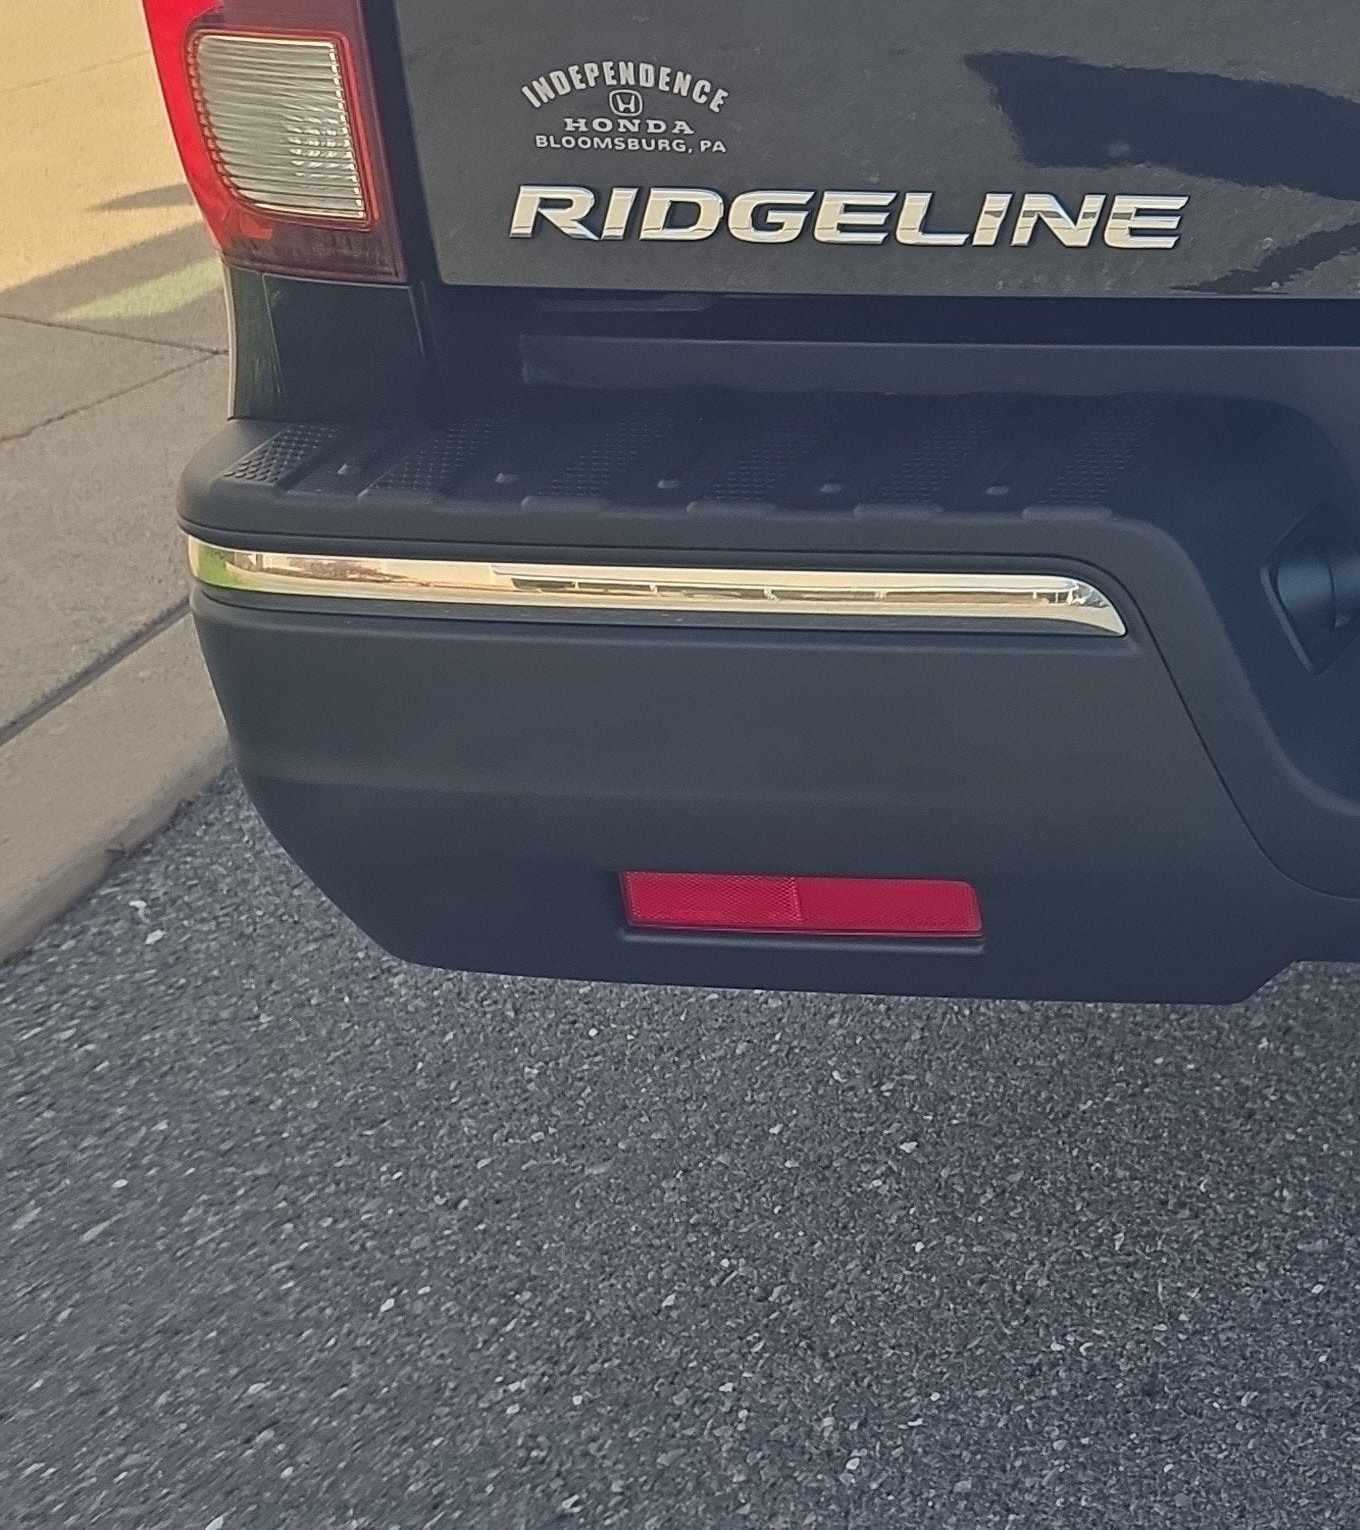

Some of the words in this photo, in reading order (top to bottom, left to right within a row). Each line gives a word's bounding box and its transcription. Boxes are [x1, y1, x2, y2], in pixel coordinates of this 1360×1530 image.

[521, 61, 729, 113] INDEPENDENCE
[564, 118, 694, 135] HONDA
[535, 135, 693, 154] BLOOMSBURG,
[700, 141, 727, 153] PA
[509, 184, 1190, 249] RIDGELINE
